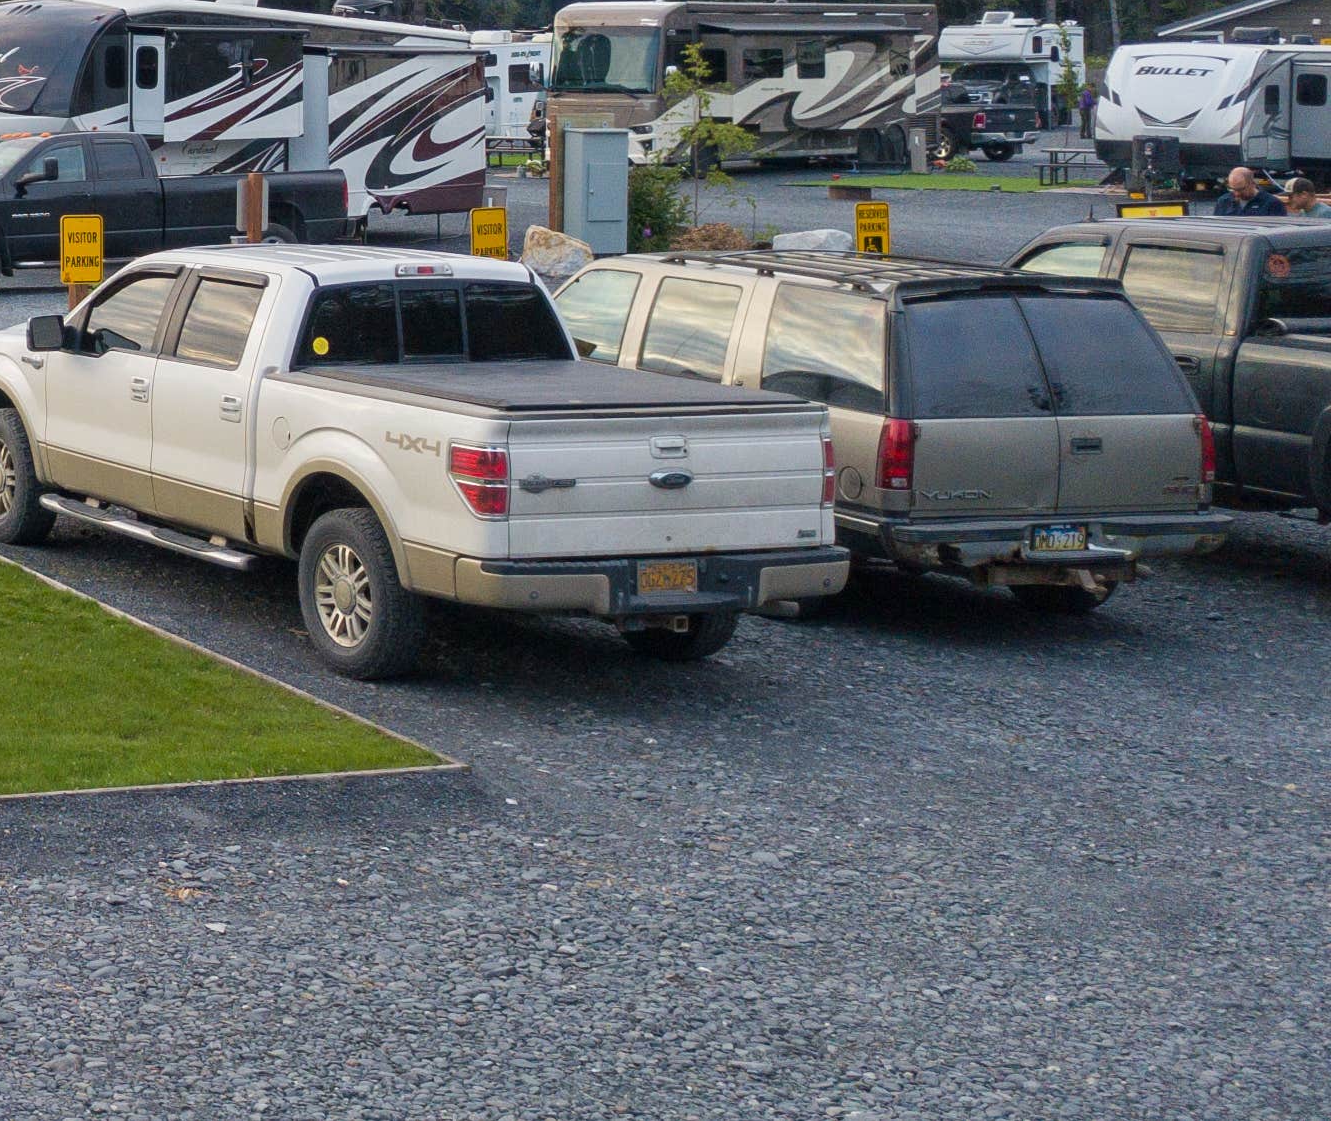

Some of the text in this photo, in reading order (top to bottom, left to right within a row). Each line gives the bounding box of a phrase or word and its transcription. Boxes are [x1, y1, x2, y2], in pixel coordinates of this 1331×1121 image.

[1135, 65, 1215, 77] BULLET
[476, 222, 503, 236] VISITOR
[859, 222, 886, 232] PARKING
[67, 231, 98, 244] VISITOR
[65, 255, 100, 268] PARKING
